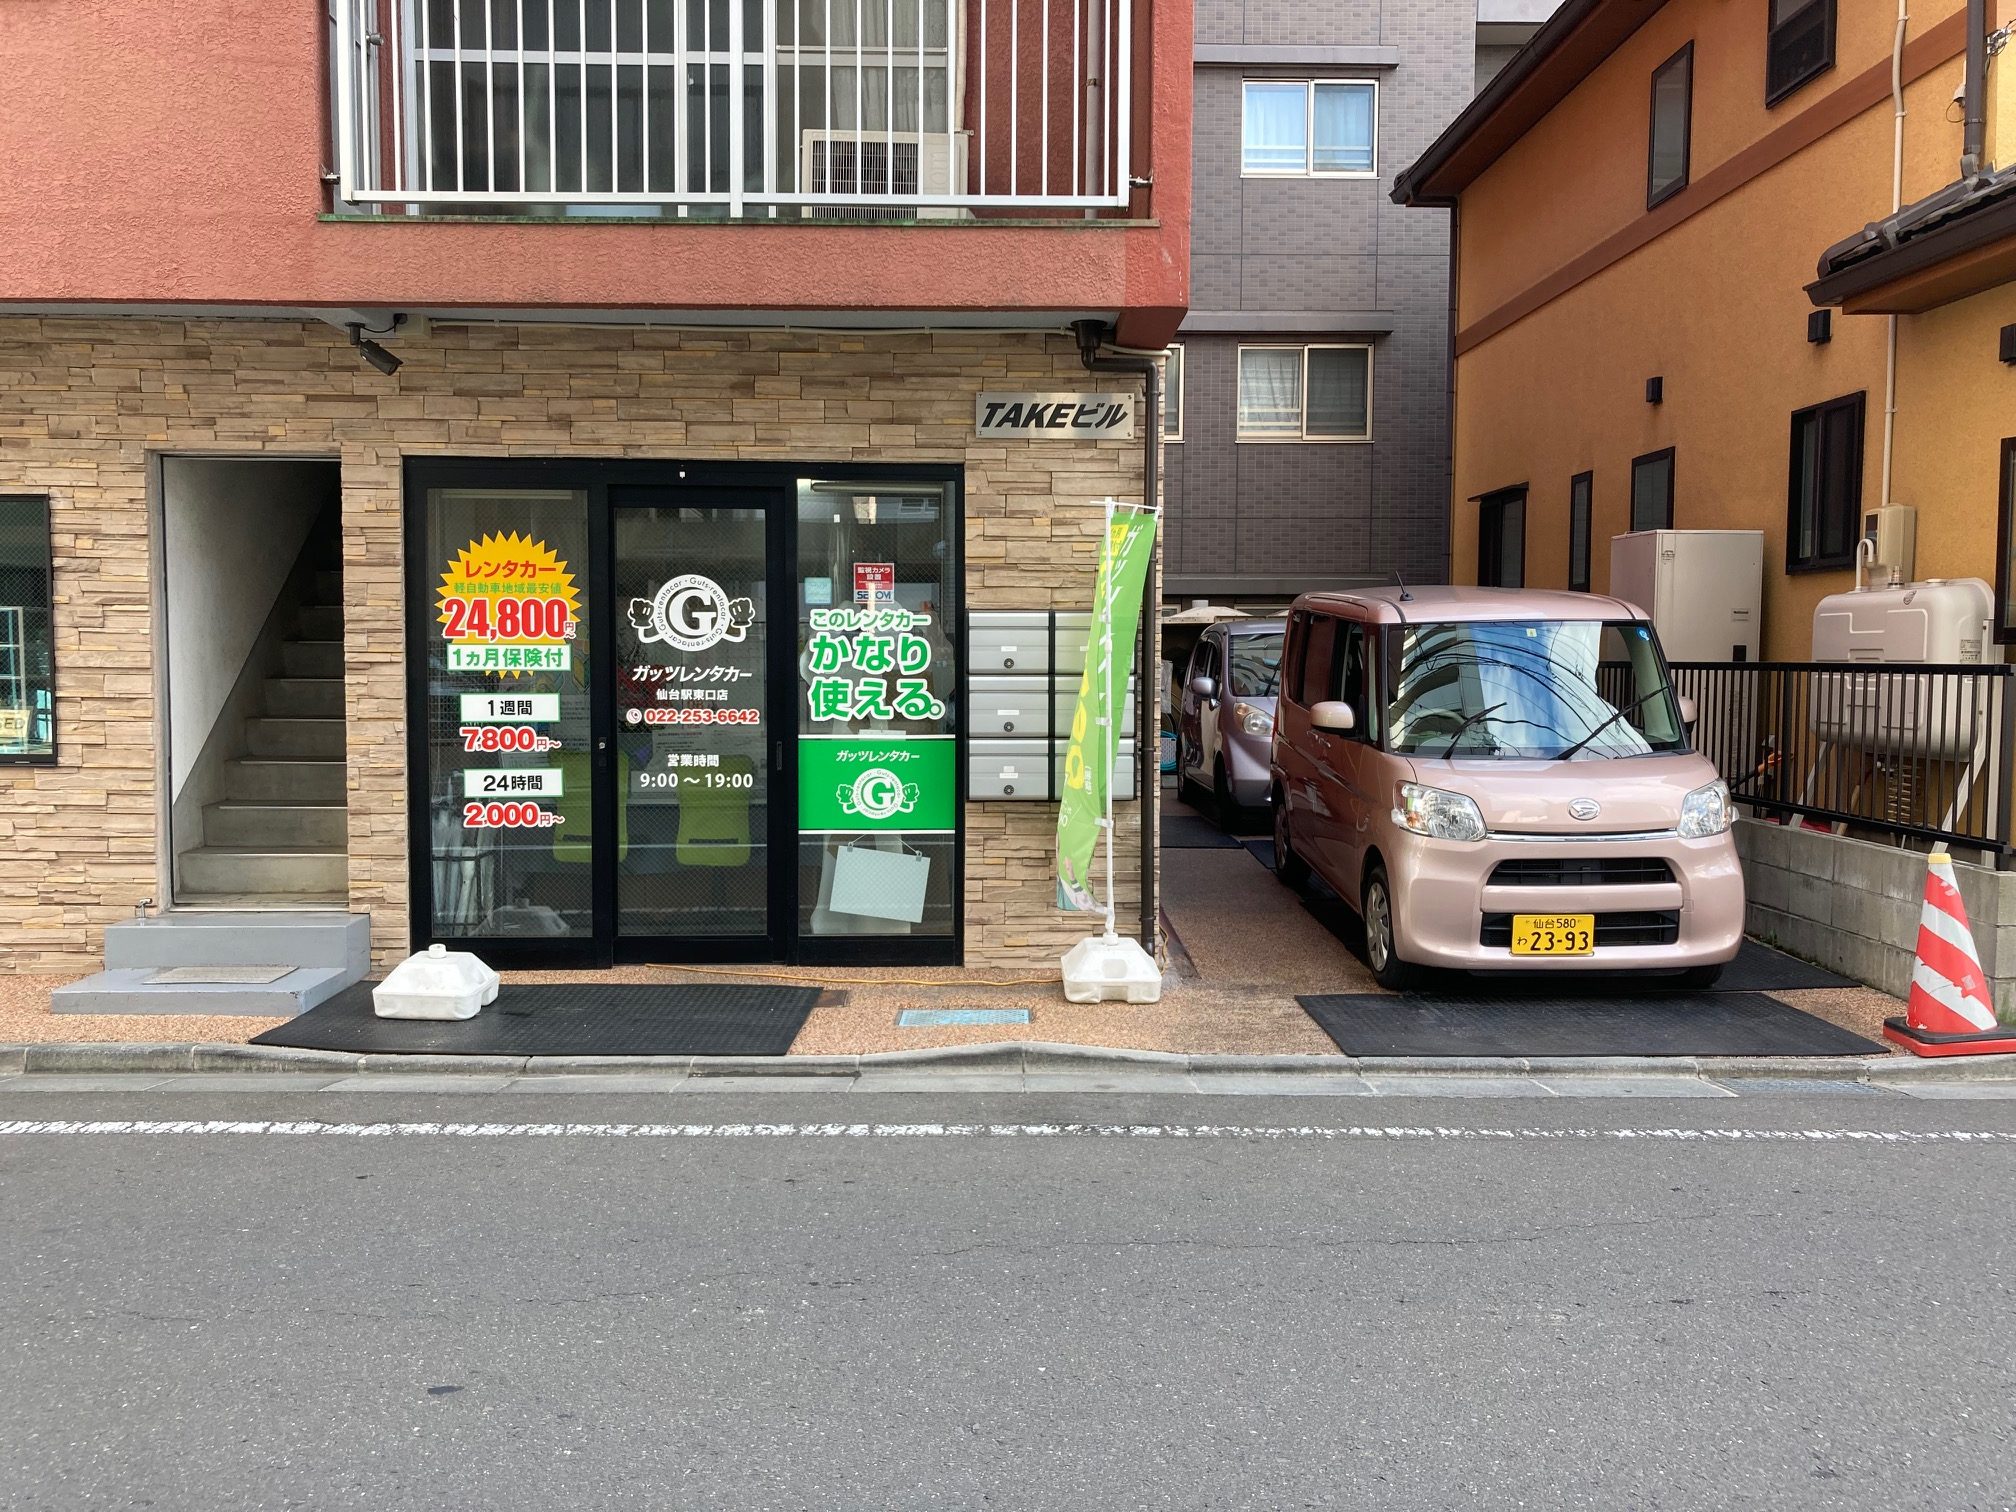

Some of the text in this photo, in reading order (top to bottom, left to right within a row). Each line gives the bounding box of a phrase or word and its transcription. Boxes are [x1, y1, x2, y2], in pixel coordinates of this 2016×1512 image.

[981, 403, 1128, 429] TAKEビル
[465, 560, 556, 579] レンタカー
[453, 582, 562, 594] 軽自動車地域最安値
[857, 591, 891, 599] SEOM
[812, 610, 930, 630] このレンタカー
[811, 633, 930, 673] かなり
[632, 665, 752, 682] ガッツレンタカー
[656, 689, 728, 701] 仙台駅東口店
[810, 679, 943, 719] 使える。
[488, 700, 533, 716] 1週間
[644, 709, 759, 724] 022-253-6642
[667, 754, 720, 767] 営業時間
[836, 750, 920, 762] ガッツレンタカー
[483, 775, 543, 791] 24時間
[640, 773, 678, 788] 9:00
[705, 773, 753, 788] 19:00
[1517, 930, 1589, 951] わ 23-93
